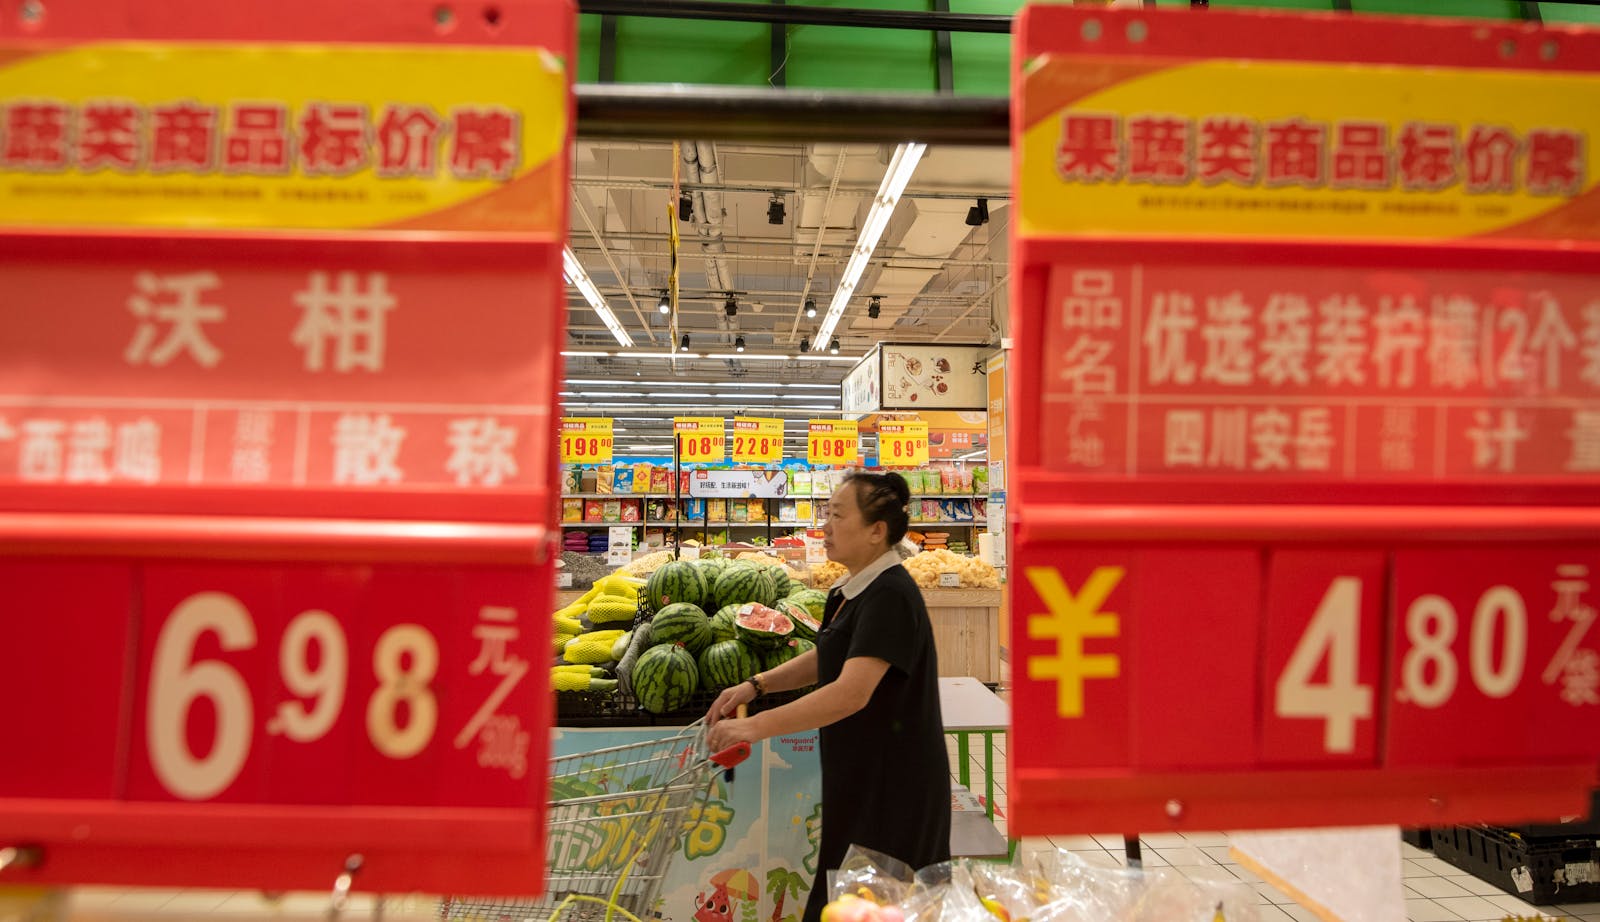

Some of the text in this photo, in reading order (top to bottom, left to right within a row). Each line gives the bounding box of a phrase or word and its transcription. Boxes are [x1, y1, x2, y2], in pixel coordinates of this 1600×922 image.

[0, 99, 521, 180] 蔬类商品标价牌
[1056, 112, 1588, 196] 果蔬类商品标价牌
[1025, 565, 1126, 719] ¥
